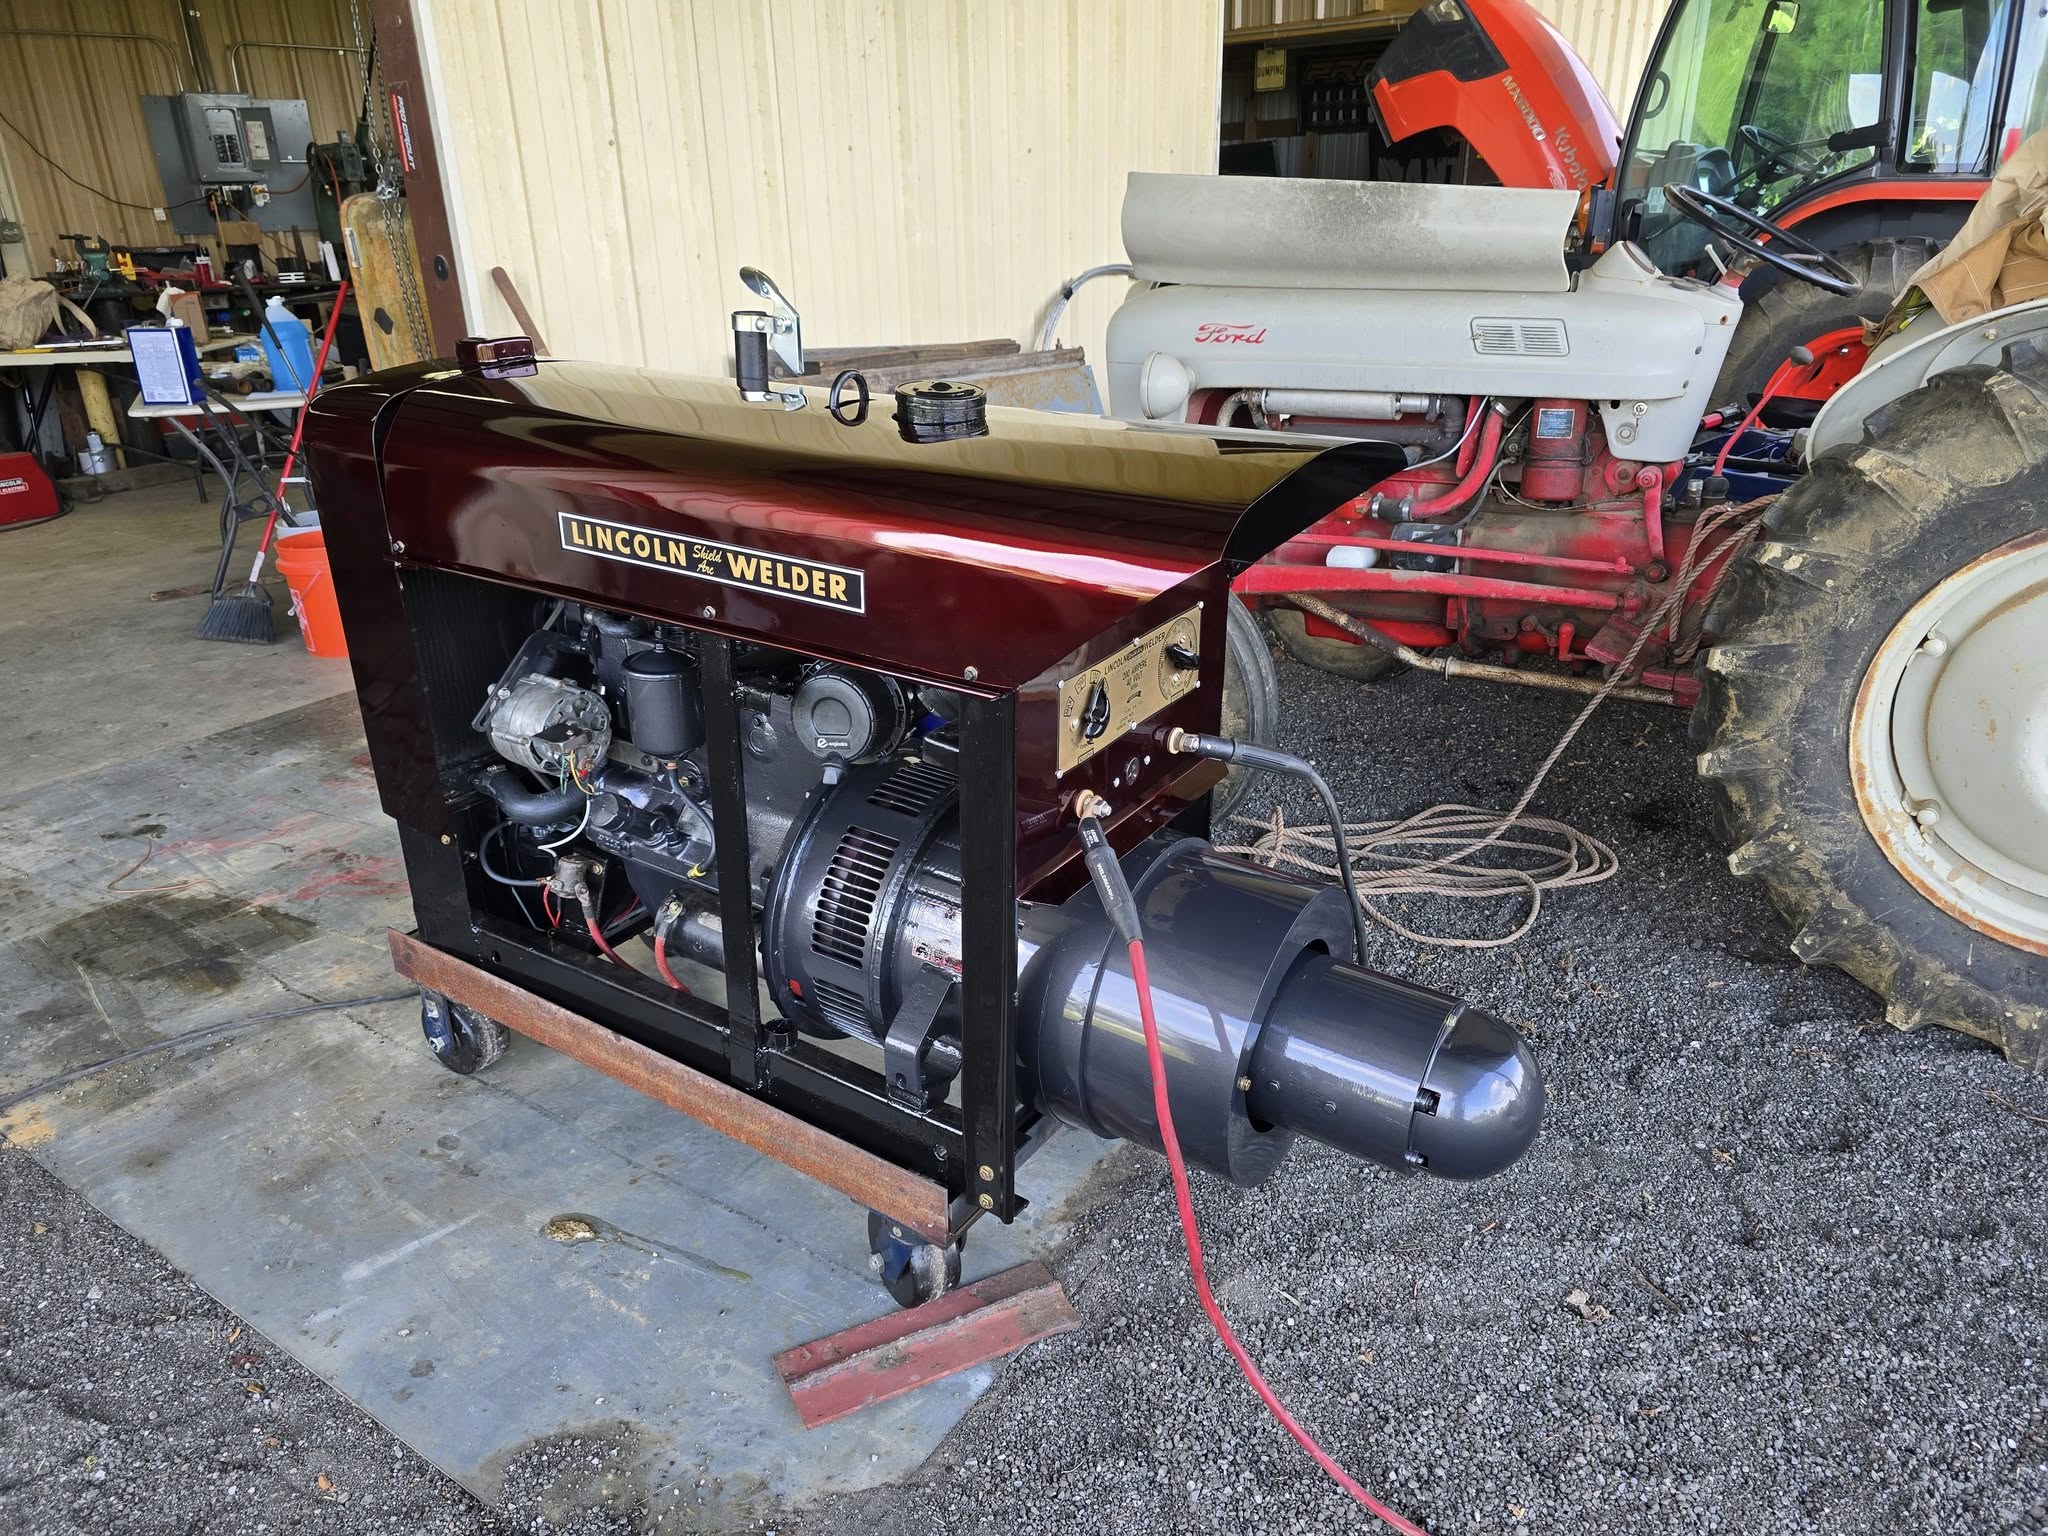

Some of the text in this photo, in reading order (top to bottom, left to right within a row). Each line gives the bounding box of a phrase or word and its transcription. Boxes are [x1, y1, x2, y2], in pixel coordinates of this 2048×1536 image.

[1256, 64, 1285, 78] DUMPING
[1556, 125, 1588, 189] Kubota
[1195, 323, 1267, 344] Ford
[571, 520, 848, 601] LINCOLN WELDER
[693, 545, 722, 562] Shield
[696, 560, 714, 576] Arc
[1104, 631, 1166, 675] LINCOLN WELDER
[1096, 862, 1114, 900] WELDMARK
